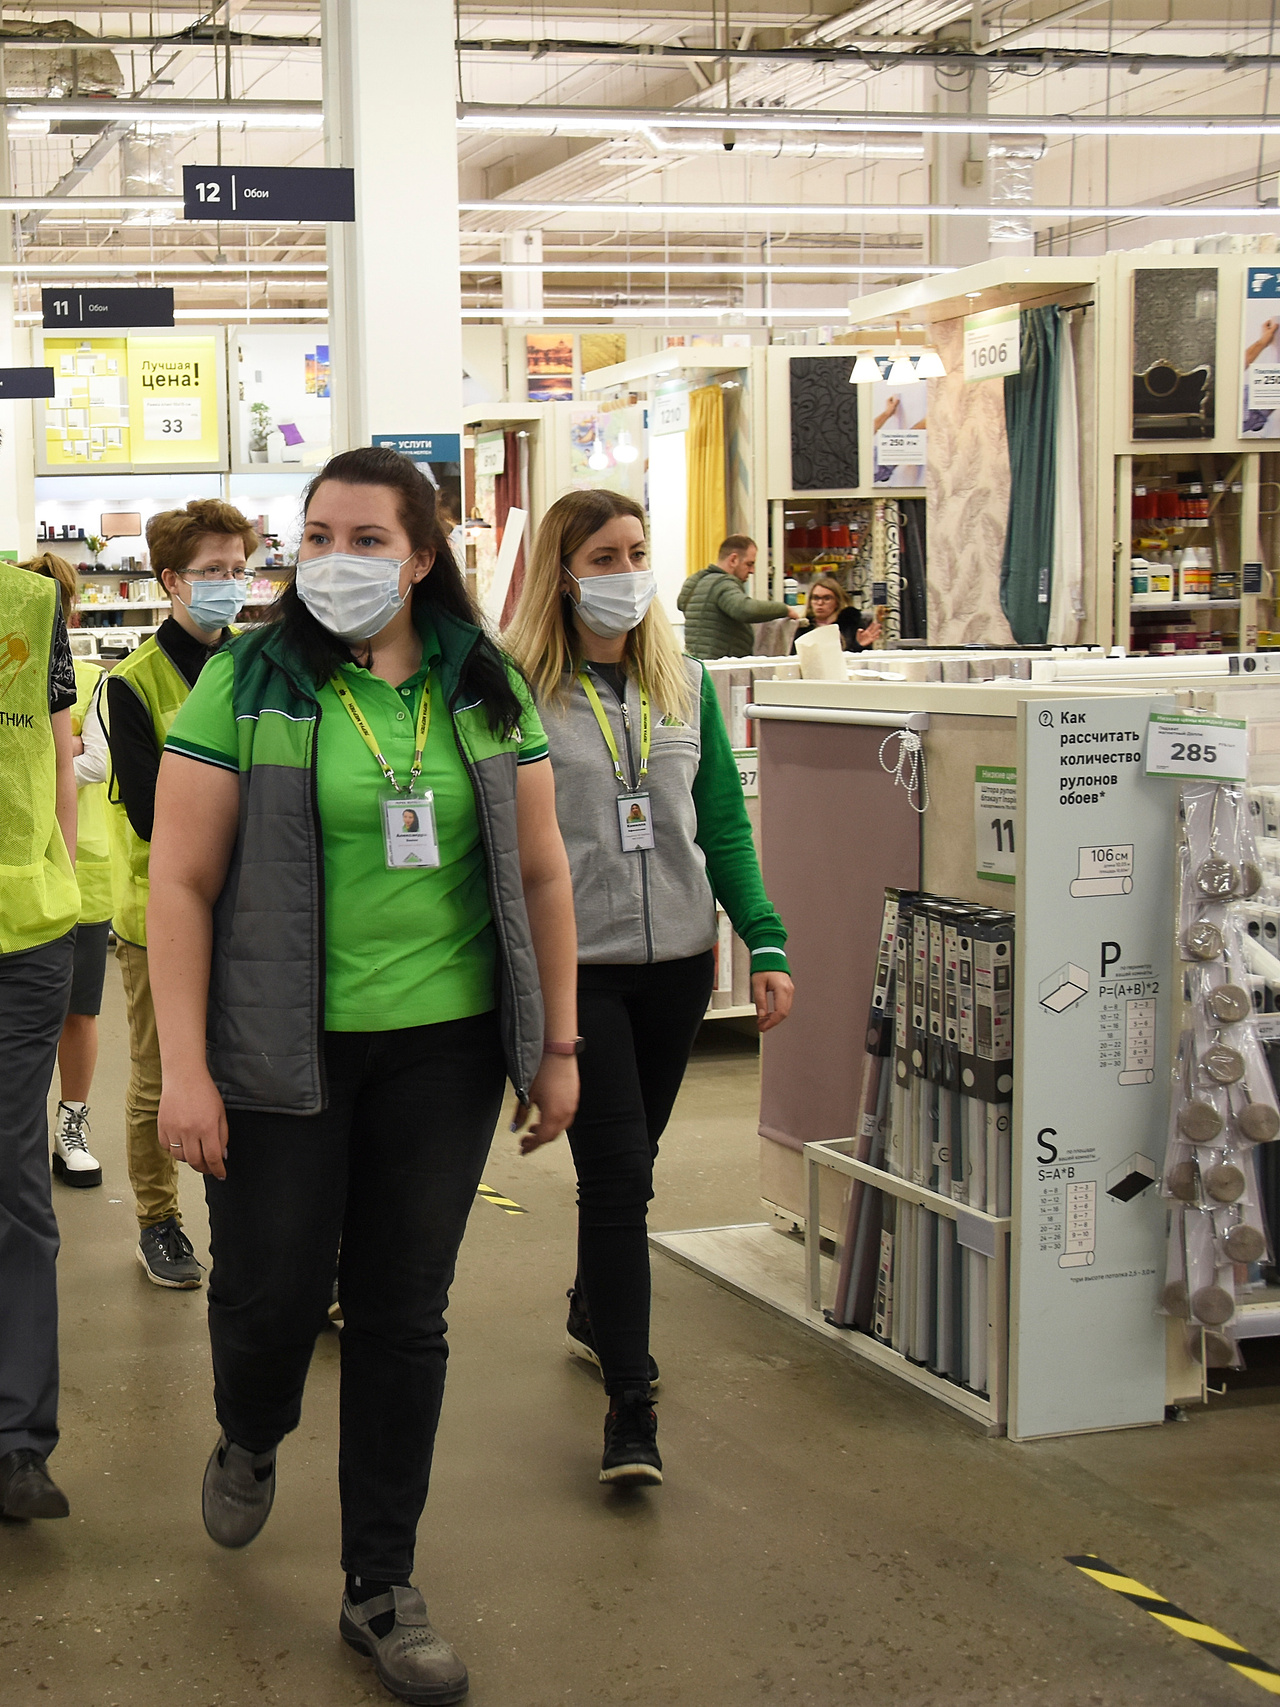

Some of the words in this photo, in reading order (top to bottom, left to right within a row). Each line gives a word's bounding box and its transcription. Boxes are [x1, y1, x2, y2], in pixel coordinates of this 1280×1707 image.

[195, 182, 221, 202] 12
[243, 188, 269, 198] Обои
[53, 300, 69, 316] 11
[88, 304, 109, 312] Обои
[971, 342, 1007, 368] 1606
[141, 360, 191, 373] Лучшая
[142, 363, 199, 391] цена!
[161, 419, 183, 433] 33
[398, 440, 432, 449] УСЛУГИ
[1060, 711, 1087, 724] Как
[1060, 731, 1140, 747] рассчитать
[1060, 752, 1141, 766] количество
[1171, 742, 1217, 763] 285
[1060, 775, 1118, 790] рулонов
[991, 818, 1015, 853] 11
[1091, 849, 1114, 862] 106
[1115, 853, 1128, 861] см
[1100, 941, 1122, 978] P
[1036, 1127, 1058, 1164] S
